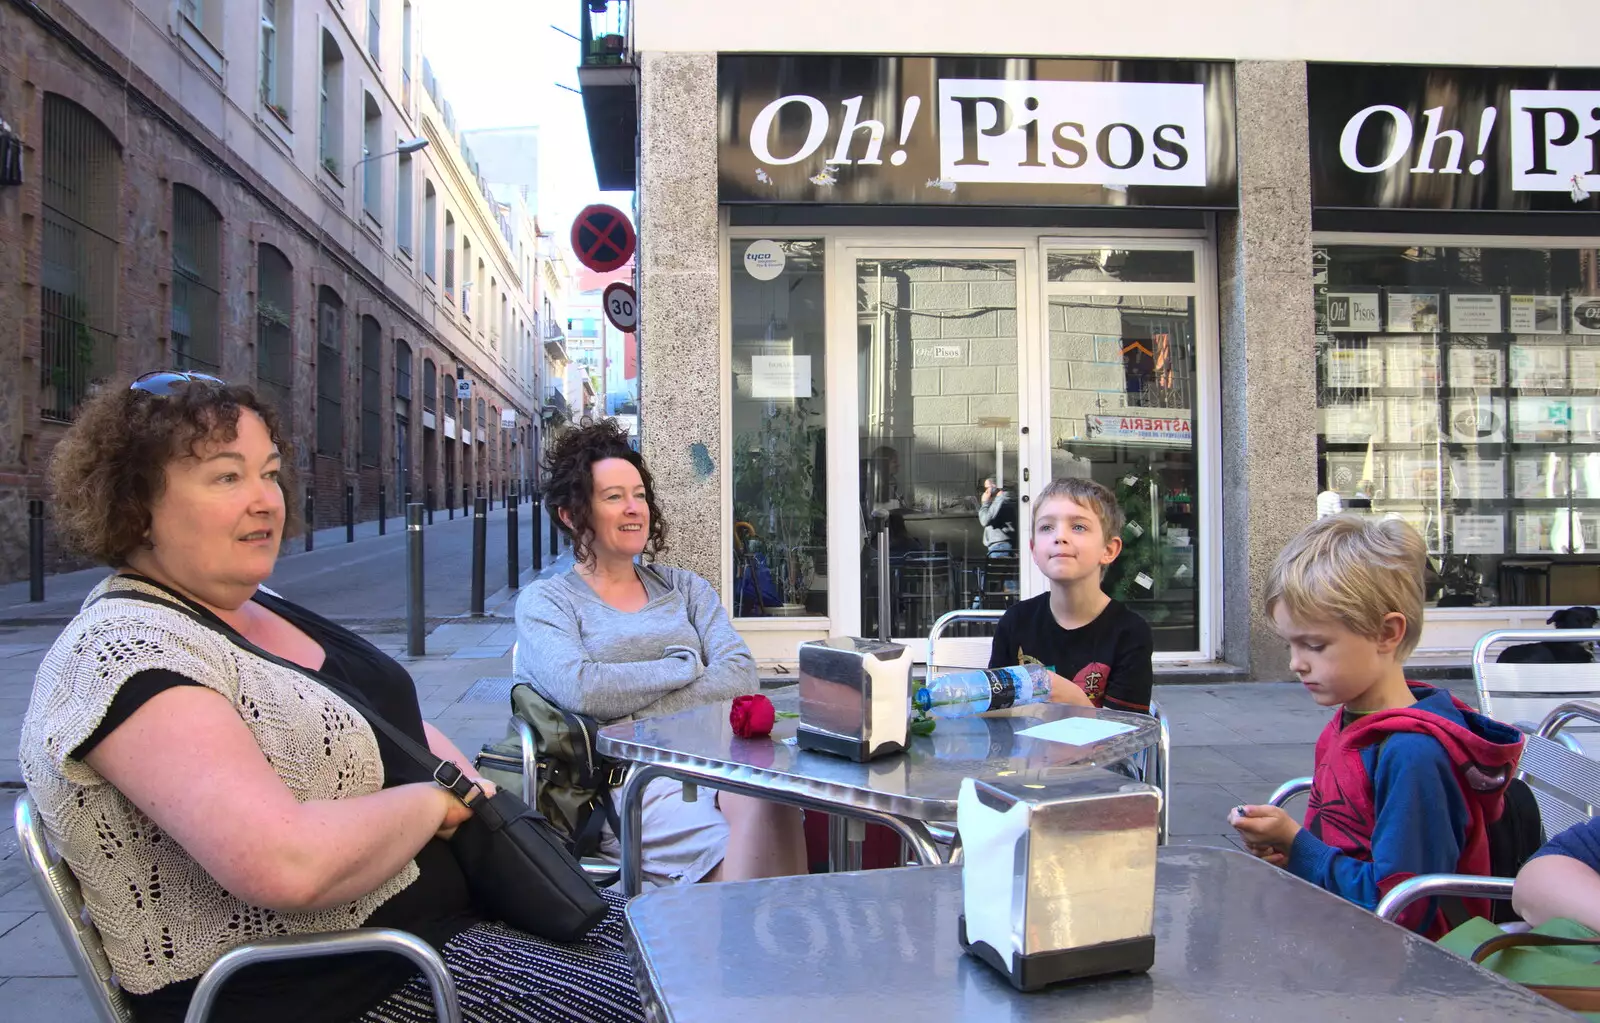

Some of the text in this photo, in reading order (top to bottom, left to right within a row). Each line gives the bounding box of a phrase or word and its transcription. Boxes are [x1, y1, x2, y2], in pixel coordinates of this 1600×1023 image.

[749, 95, 1189, 171] Oh! Pisos
[1339, 104, 1497, 176] Oh!
[746, 253, 771, 261] tyco
[611, 299, 633, 317] 30
[1330, 301, 1347, 321] Oh!
[1353, 302, 1375, 321] Pisos
[935, 347, 959, 357] Pisos
